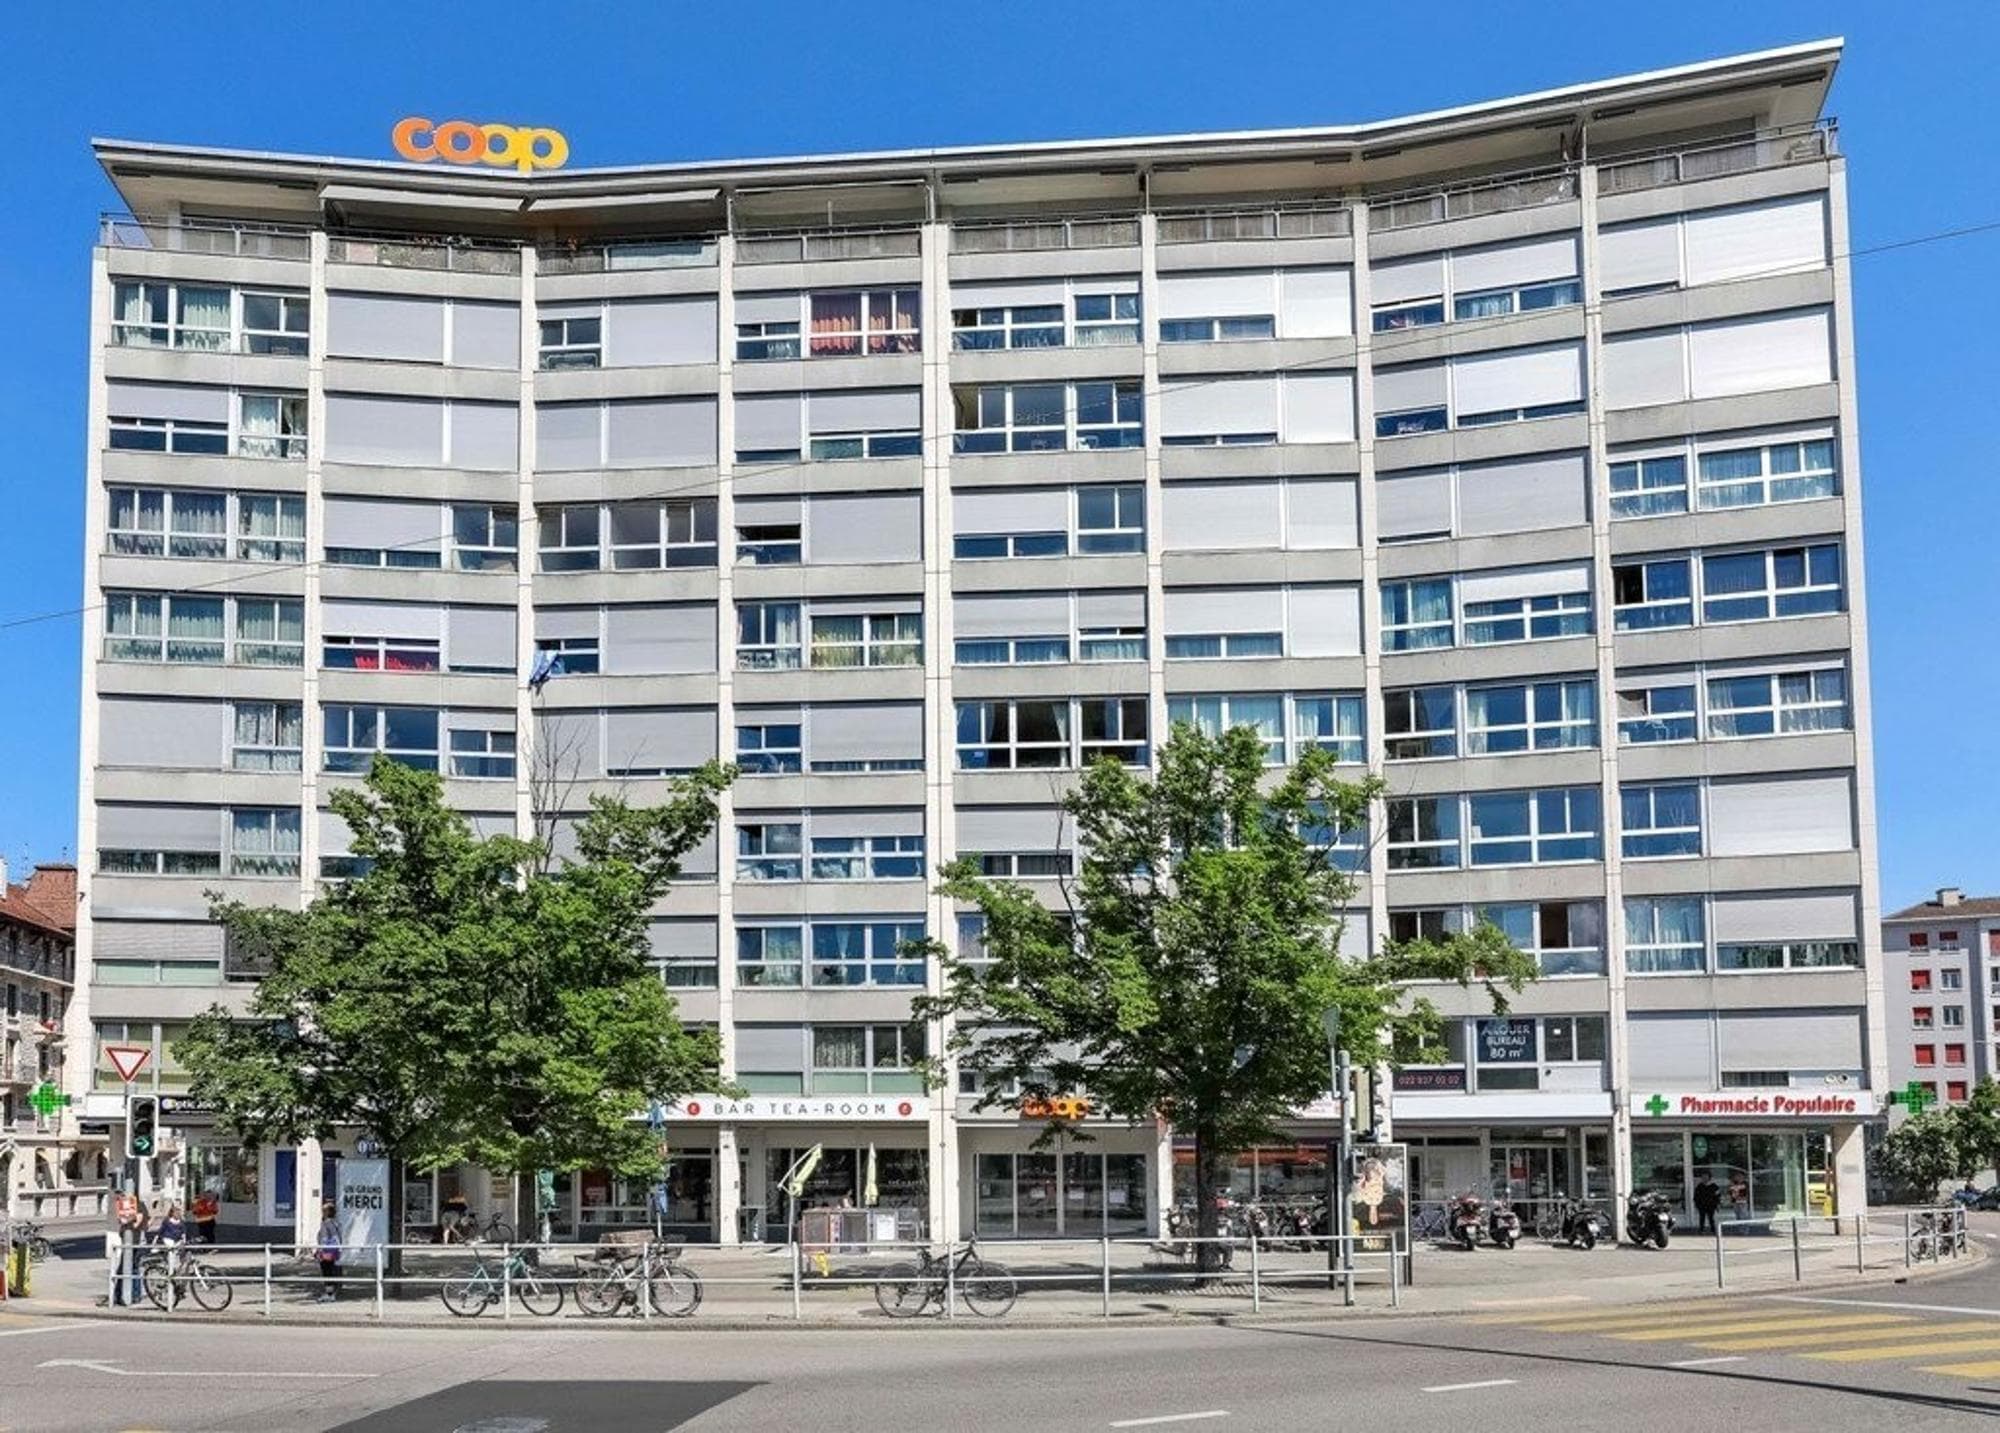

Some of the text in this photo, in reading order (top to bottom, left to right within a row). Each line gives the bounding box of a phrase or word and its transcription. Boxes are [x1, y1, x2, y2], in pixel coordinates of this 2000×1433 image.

[392, 116, 570, 178] coop
[1486, 1035, 1527, 1046] BUREAU
[1490, 1047, 1507, 1059] 80
[714, 1103, 886, 1115] BAR TEA-ROOM
[1680, 1095, 1857, 1115] Pharmacie Populaire
[343, 1195, 383, 1209] MERCI
